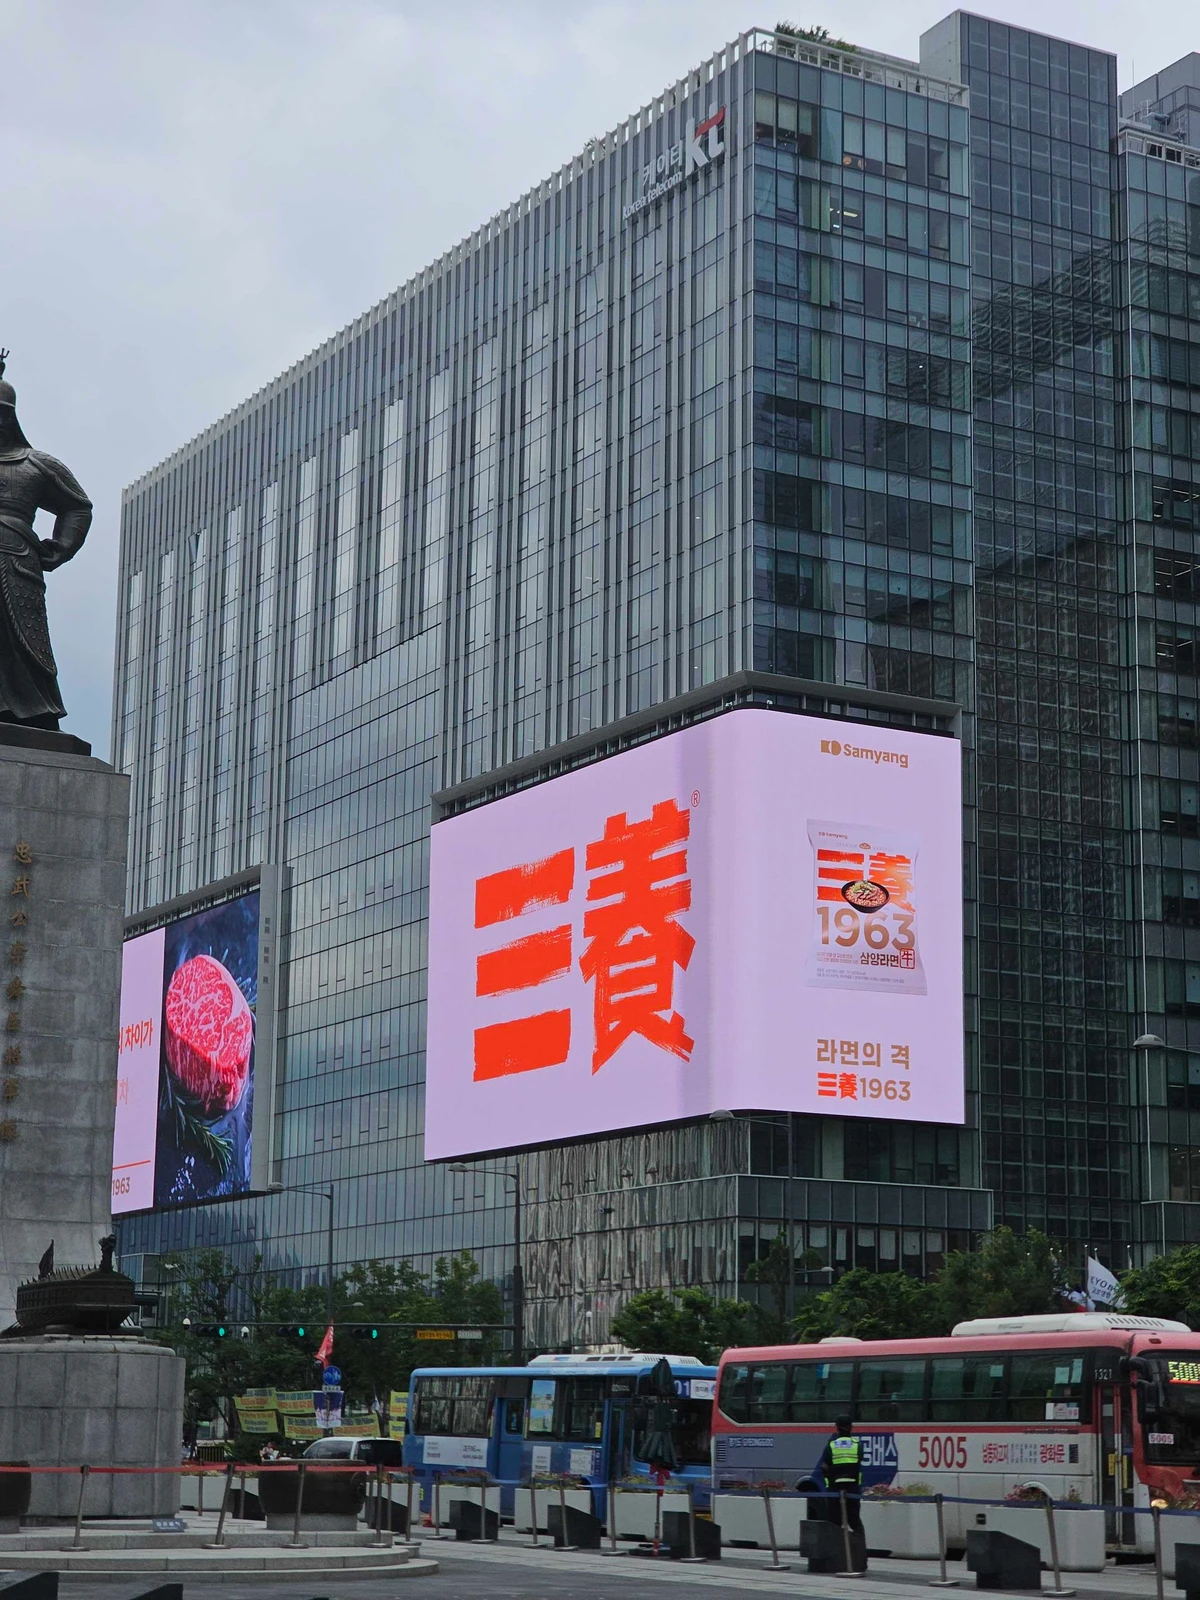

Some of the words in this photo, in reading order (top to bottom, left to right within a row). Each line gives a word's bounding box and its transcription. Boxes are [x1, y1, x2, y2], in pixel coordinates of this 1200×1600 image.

[685, 102, 726, 179] kt
[643, 140, 683, 186] 케이티
[621, 194, 647, 221] korea
[647, 171, 682, 202] telecom
[843, 743, 909, 769] Samyang
[473, 798, 696, 1082] 三養
[817, 906, 916, 951] 1963
[860, 952, 900, 968] 삼양라면
[125, 1018, 154, 1051] 차이가
[817, 1039, 882, 1068] 라면의
[891, 1045, 910, 1070] 격
[918, 1435, 968, 1469] 5005
[1150, 1434, 1173, 1444] 5005
